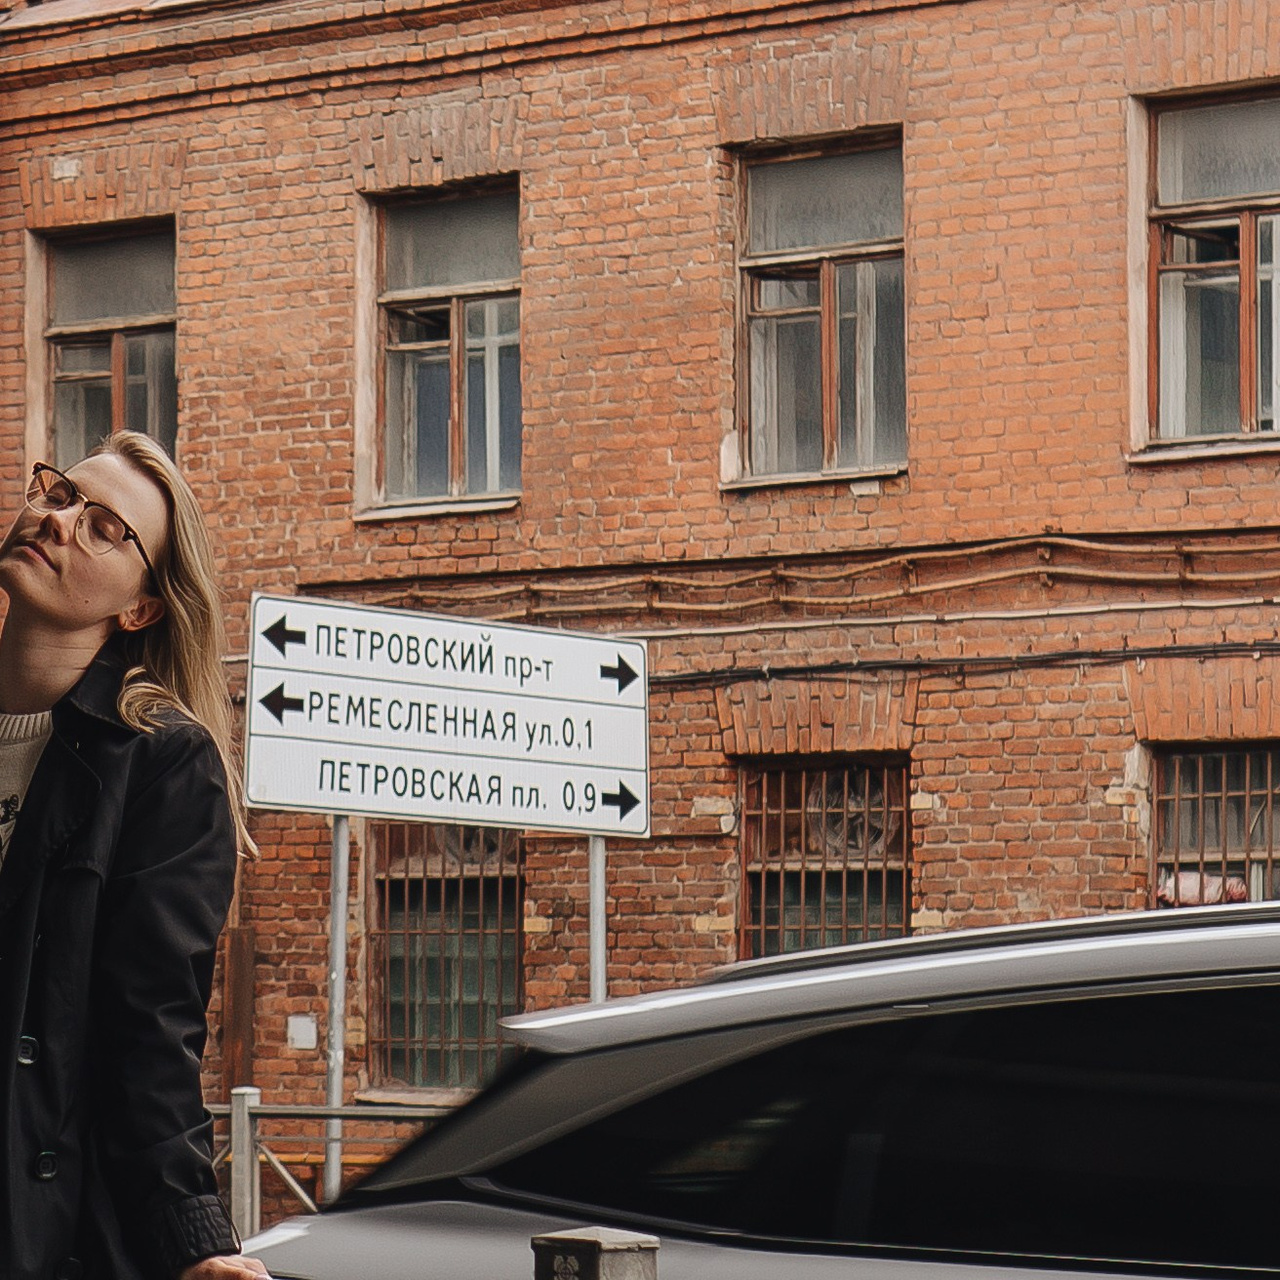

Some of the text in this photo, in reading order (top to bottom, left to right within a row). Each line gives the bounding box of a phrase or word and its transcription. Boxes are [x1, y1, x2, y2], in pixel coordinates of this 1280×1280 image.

[316, 624, 554, 688] ПЕТРОВСКИЙ пр-т
[308, 691, 516, 742] РЕМЕСЛЕННАЯ
[319, 759, 596, 817] ПЕТРОВСКАЯ пл. 0,9
